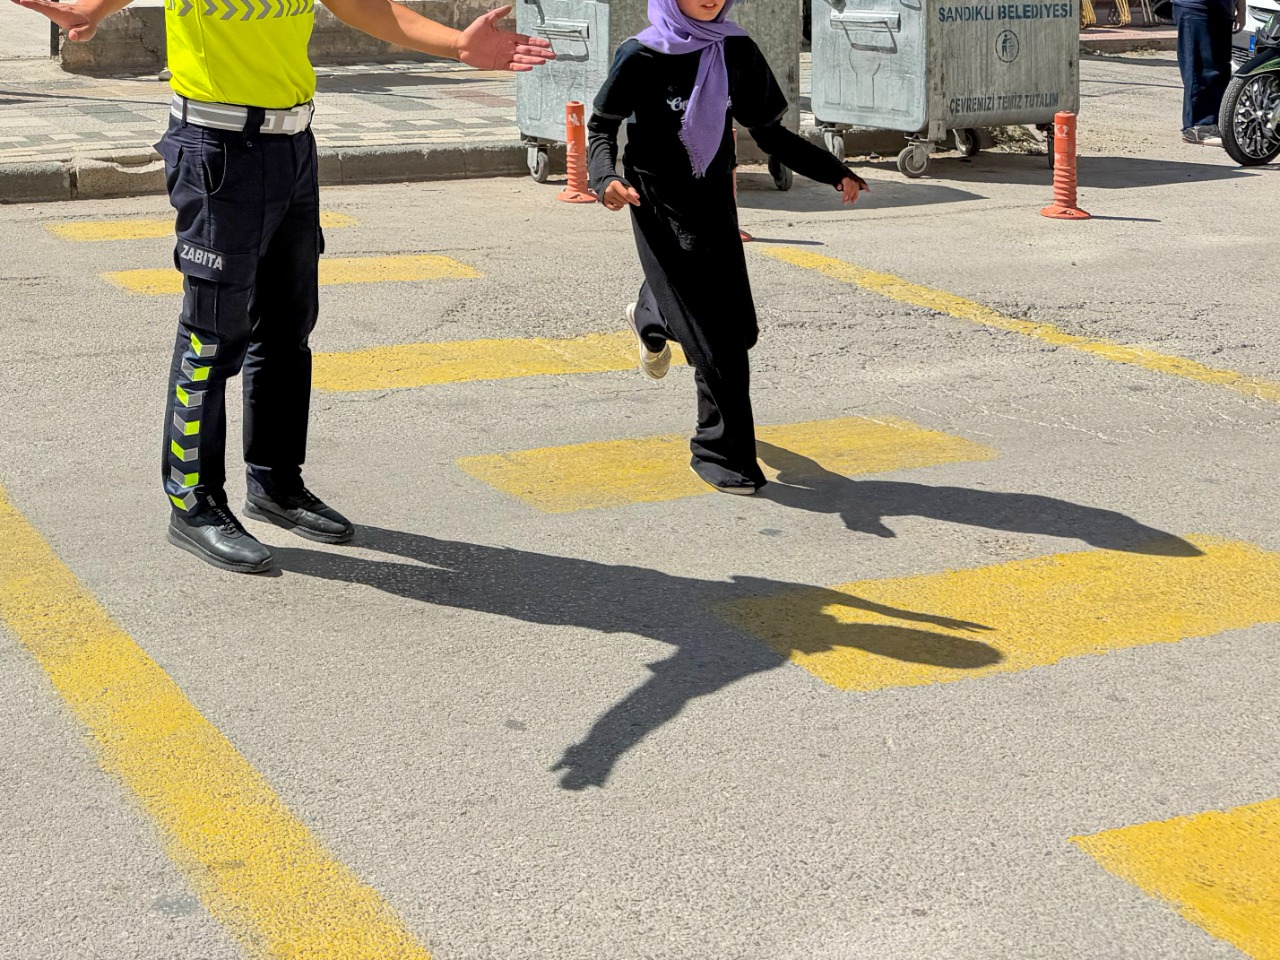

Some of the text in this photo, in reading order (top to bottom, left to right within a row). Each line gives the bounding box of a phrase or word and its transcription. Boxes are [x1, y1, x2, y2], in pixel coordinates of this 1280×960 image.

[938, 5, 994, 22] SANDIKLI
[949, 92, 1060, 115] ÇEVREMİZİ TEMİZ TUTALIM
[180, 244, 223, 271] ZABITA
